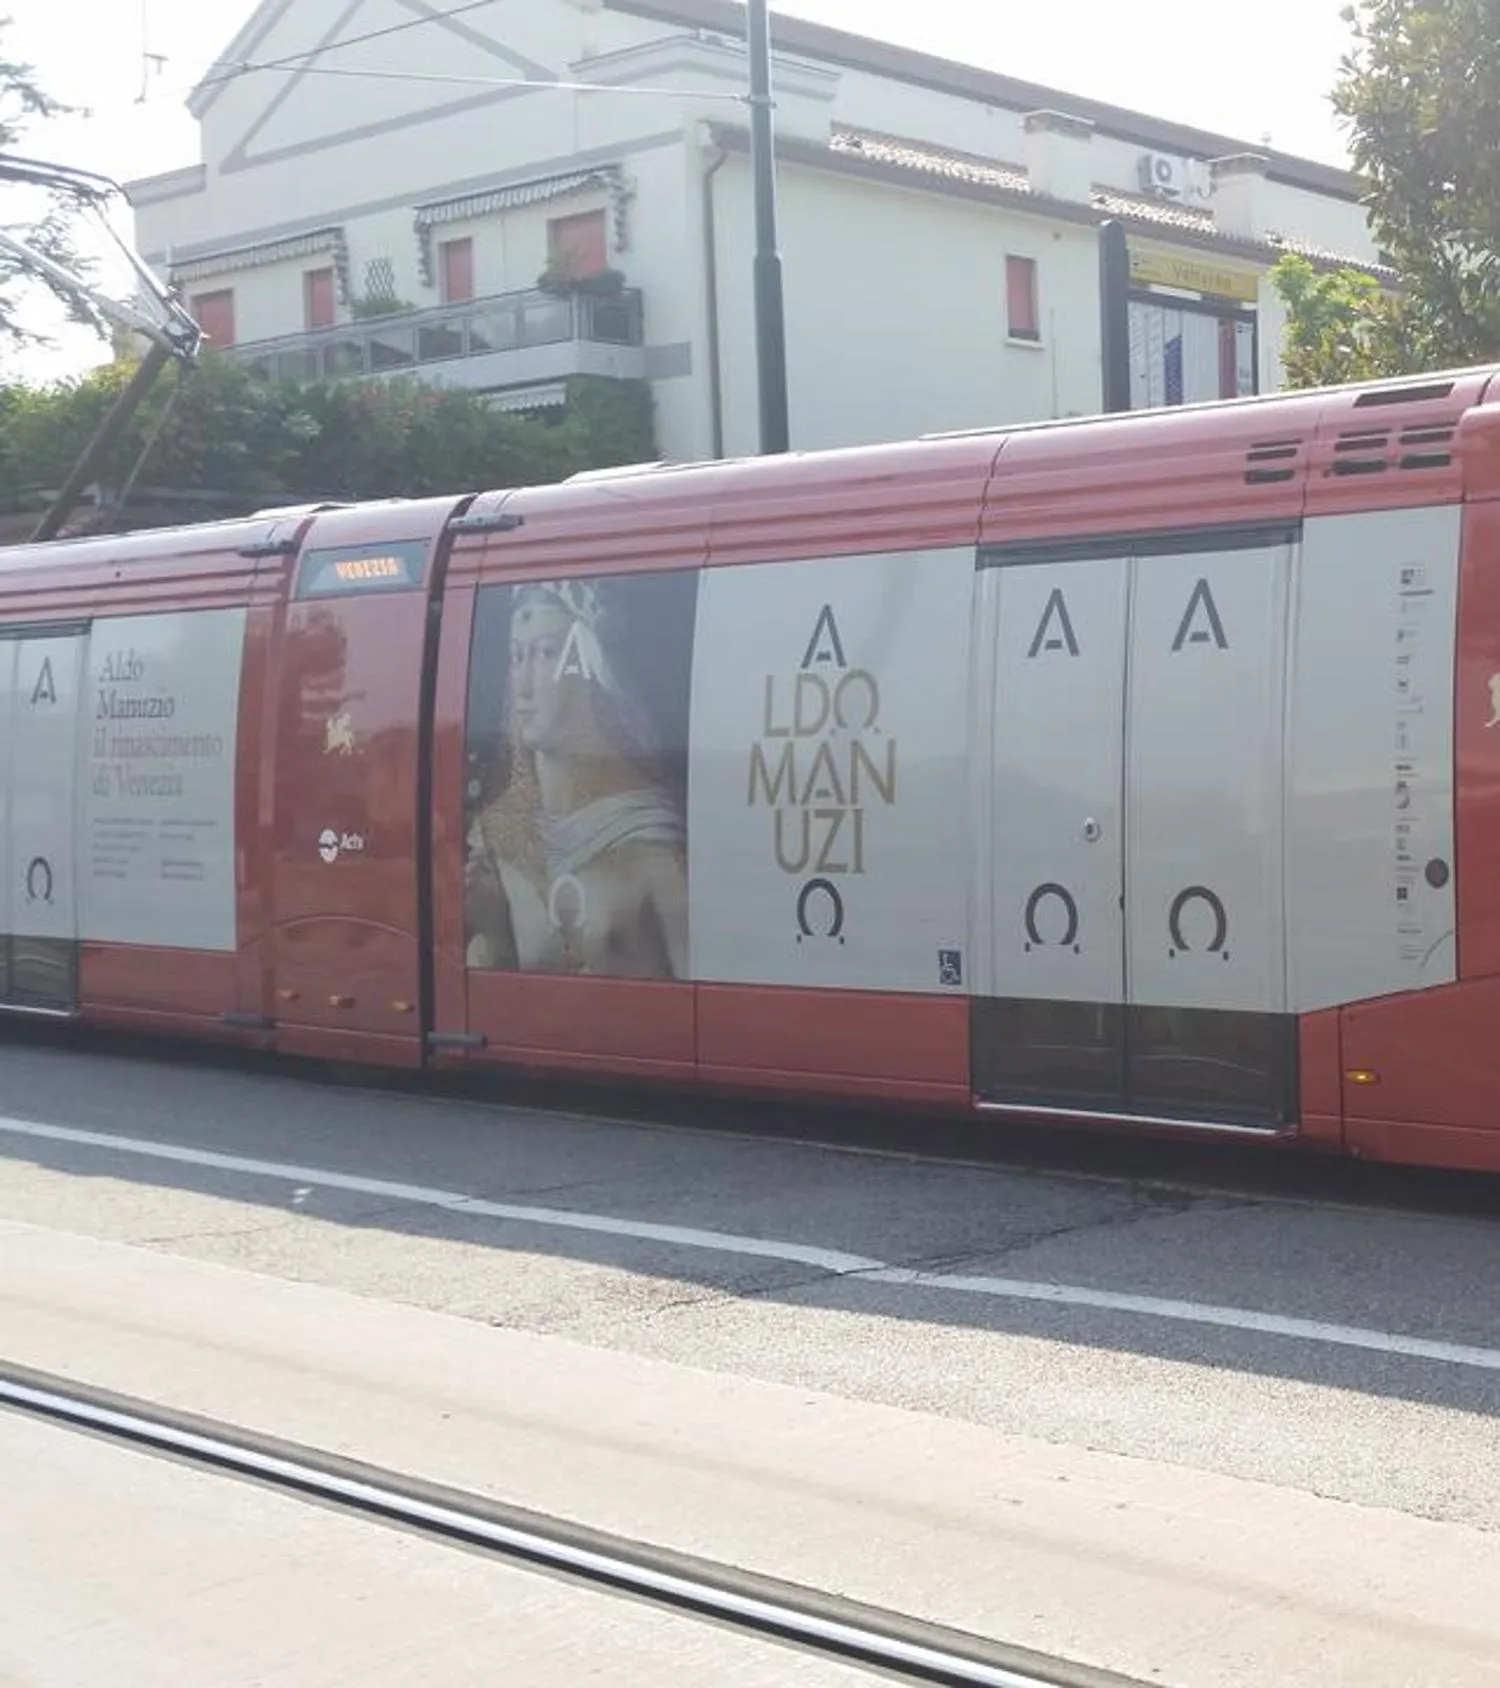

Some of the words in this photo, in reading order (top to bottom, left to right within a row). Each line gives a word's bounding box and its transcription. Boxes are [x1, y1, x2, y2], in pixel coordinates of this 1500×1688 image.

[801, 604, 847, 669] A
[1026, 587, 1080, 657] A
[1171, 578, 1230, 652] A
[30, 655, 57, 704] A
[99, 649, 144, 682] Aldo
[97, 689, 175, 720] Manuzio
[747, 739, 896, 806] MAN
[774, 808, 866, 874] UZI
